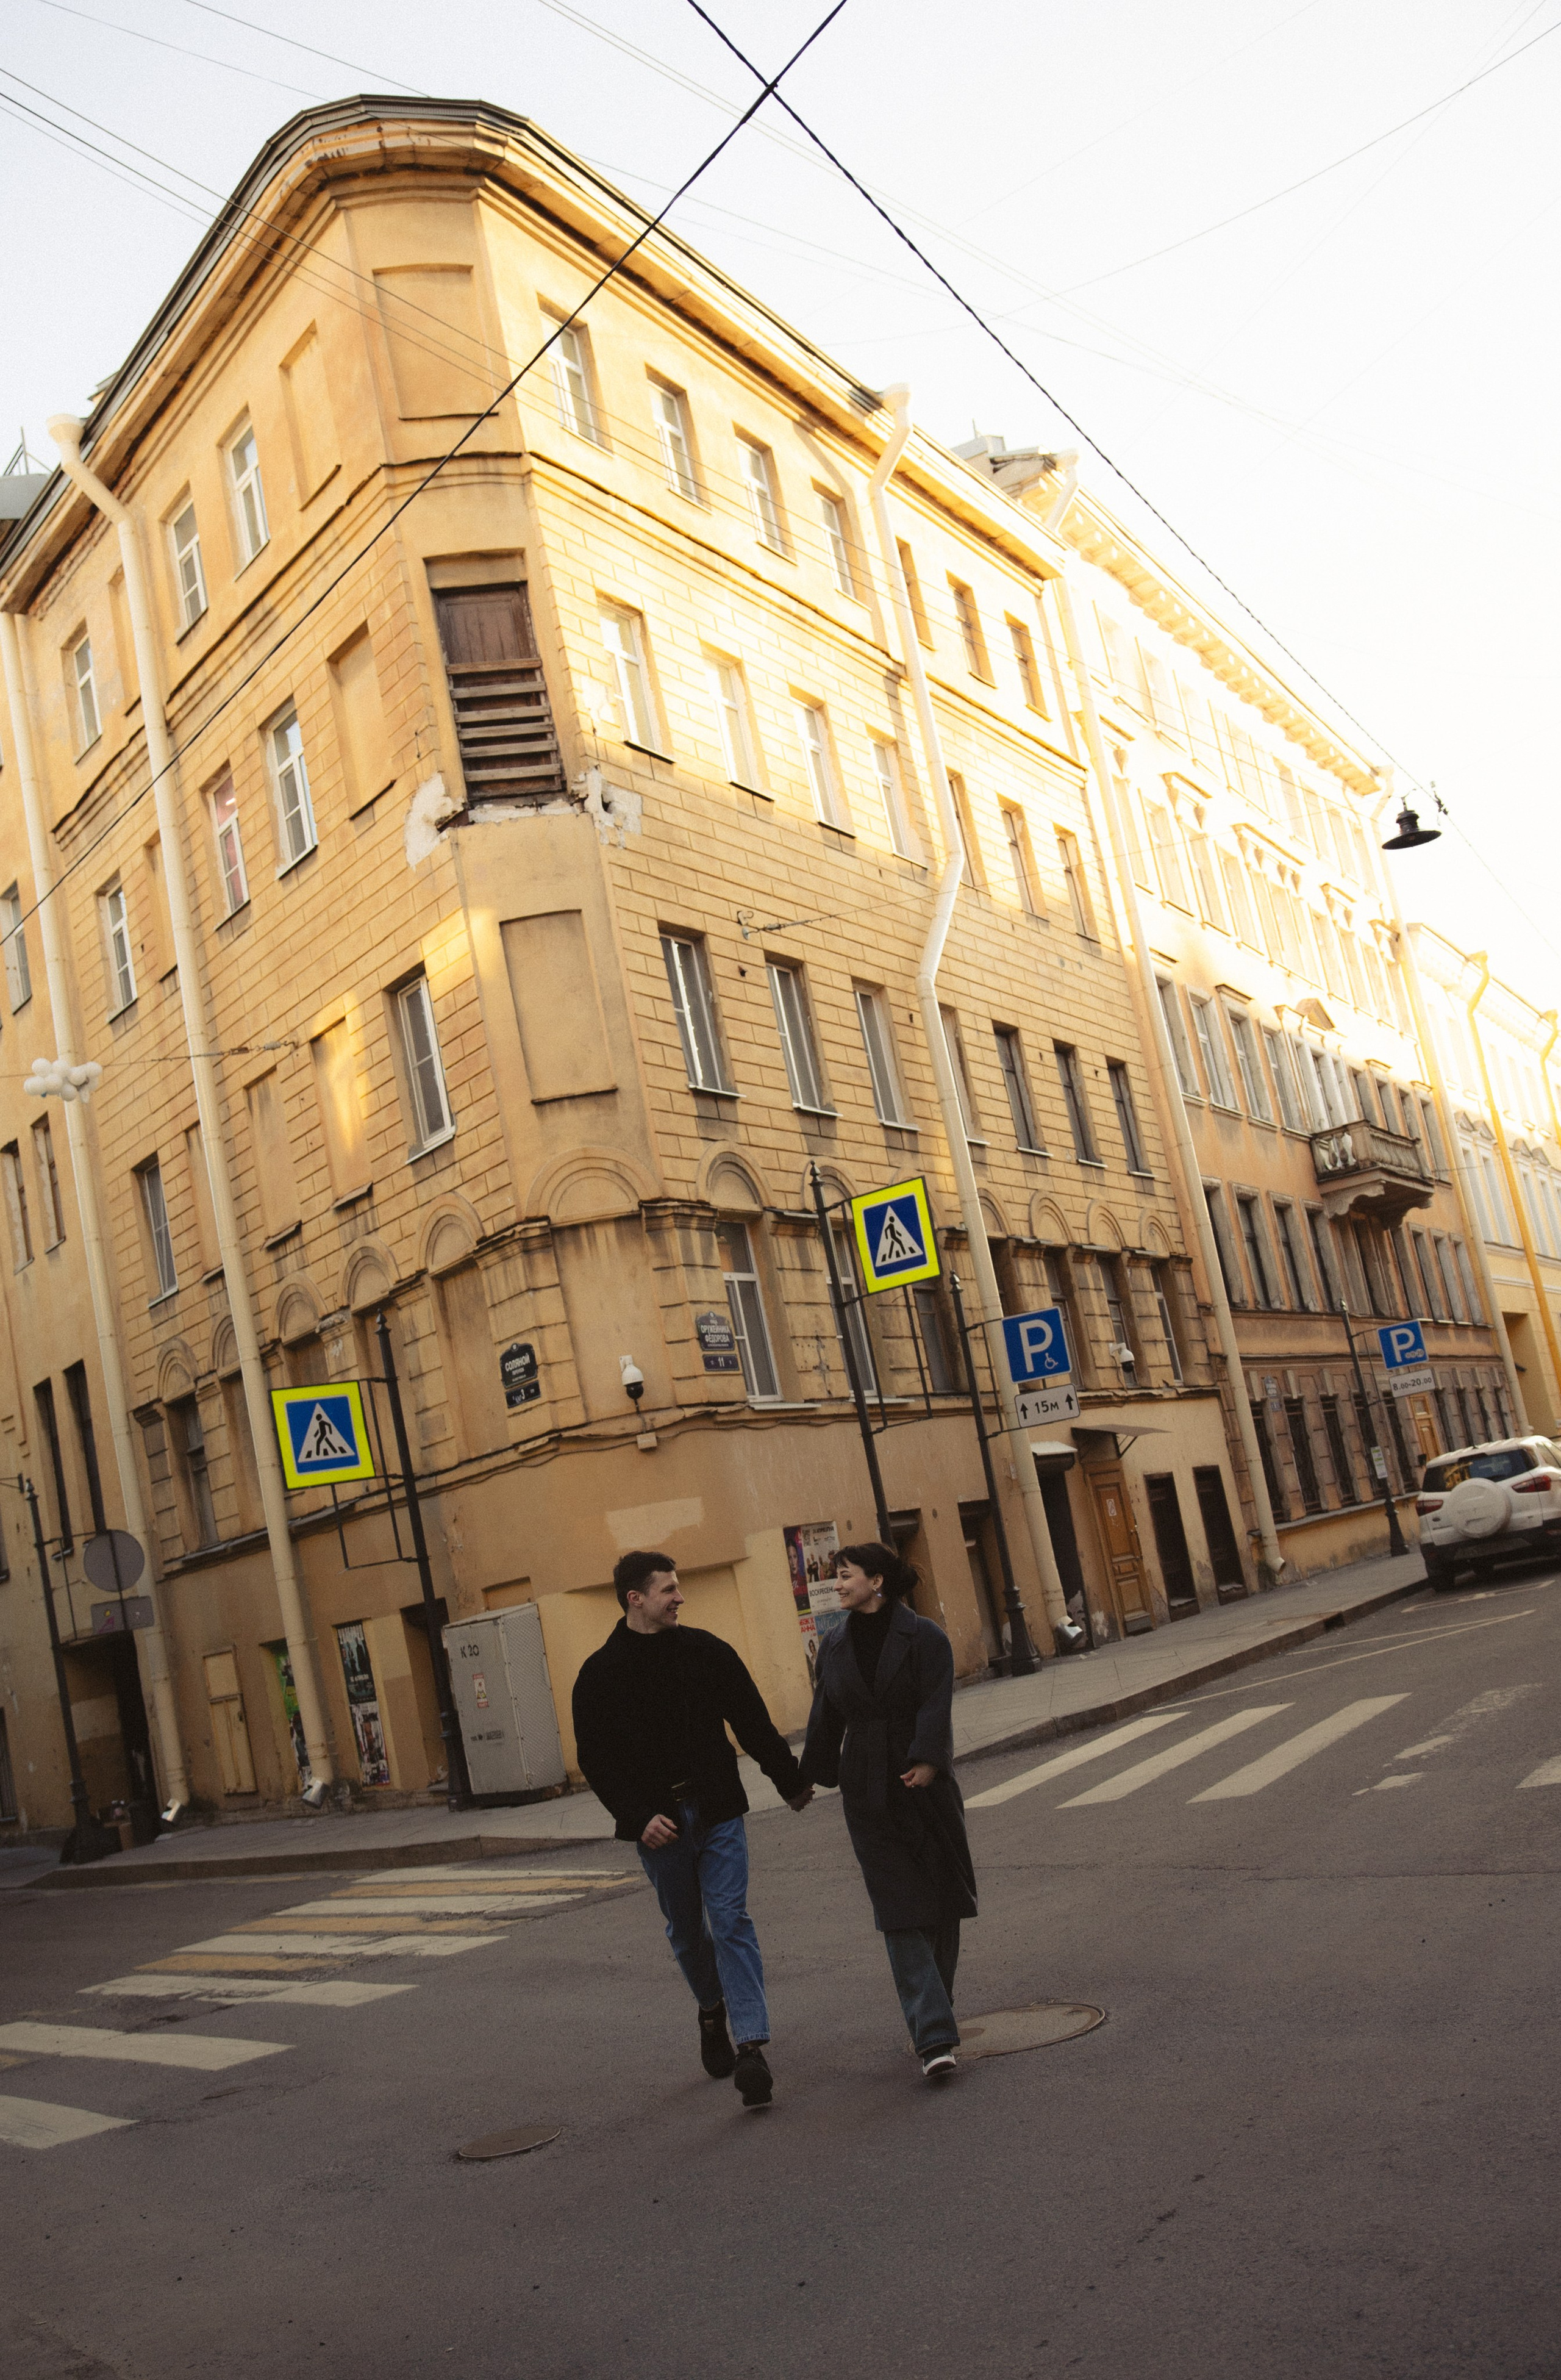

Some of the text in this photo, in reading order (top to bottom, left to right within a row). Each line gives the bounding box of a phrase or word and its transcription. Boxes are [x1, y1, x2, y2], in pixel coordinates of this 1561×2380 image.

[1019, 1319, 1053, 1373] P
[1390, 1328, 1415, 1363] P
[505, 1353, 530, 1372] СОЛЯНОЙ
[718, 1356, 724, 1367] 11
[809, 1587, 835, 1597] ВОСКРЕСЕН
